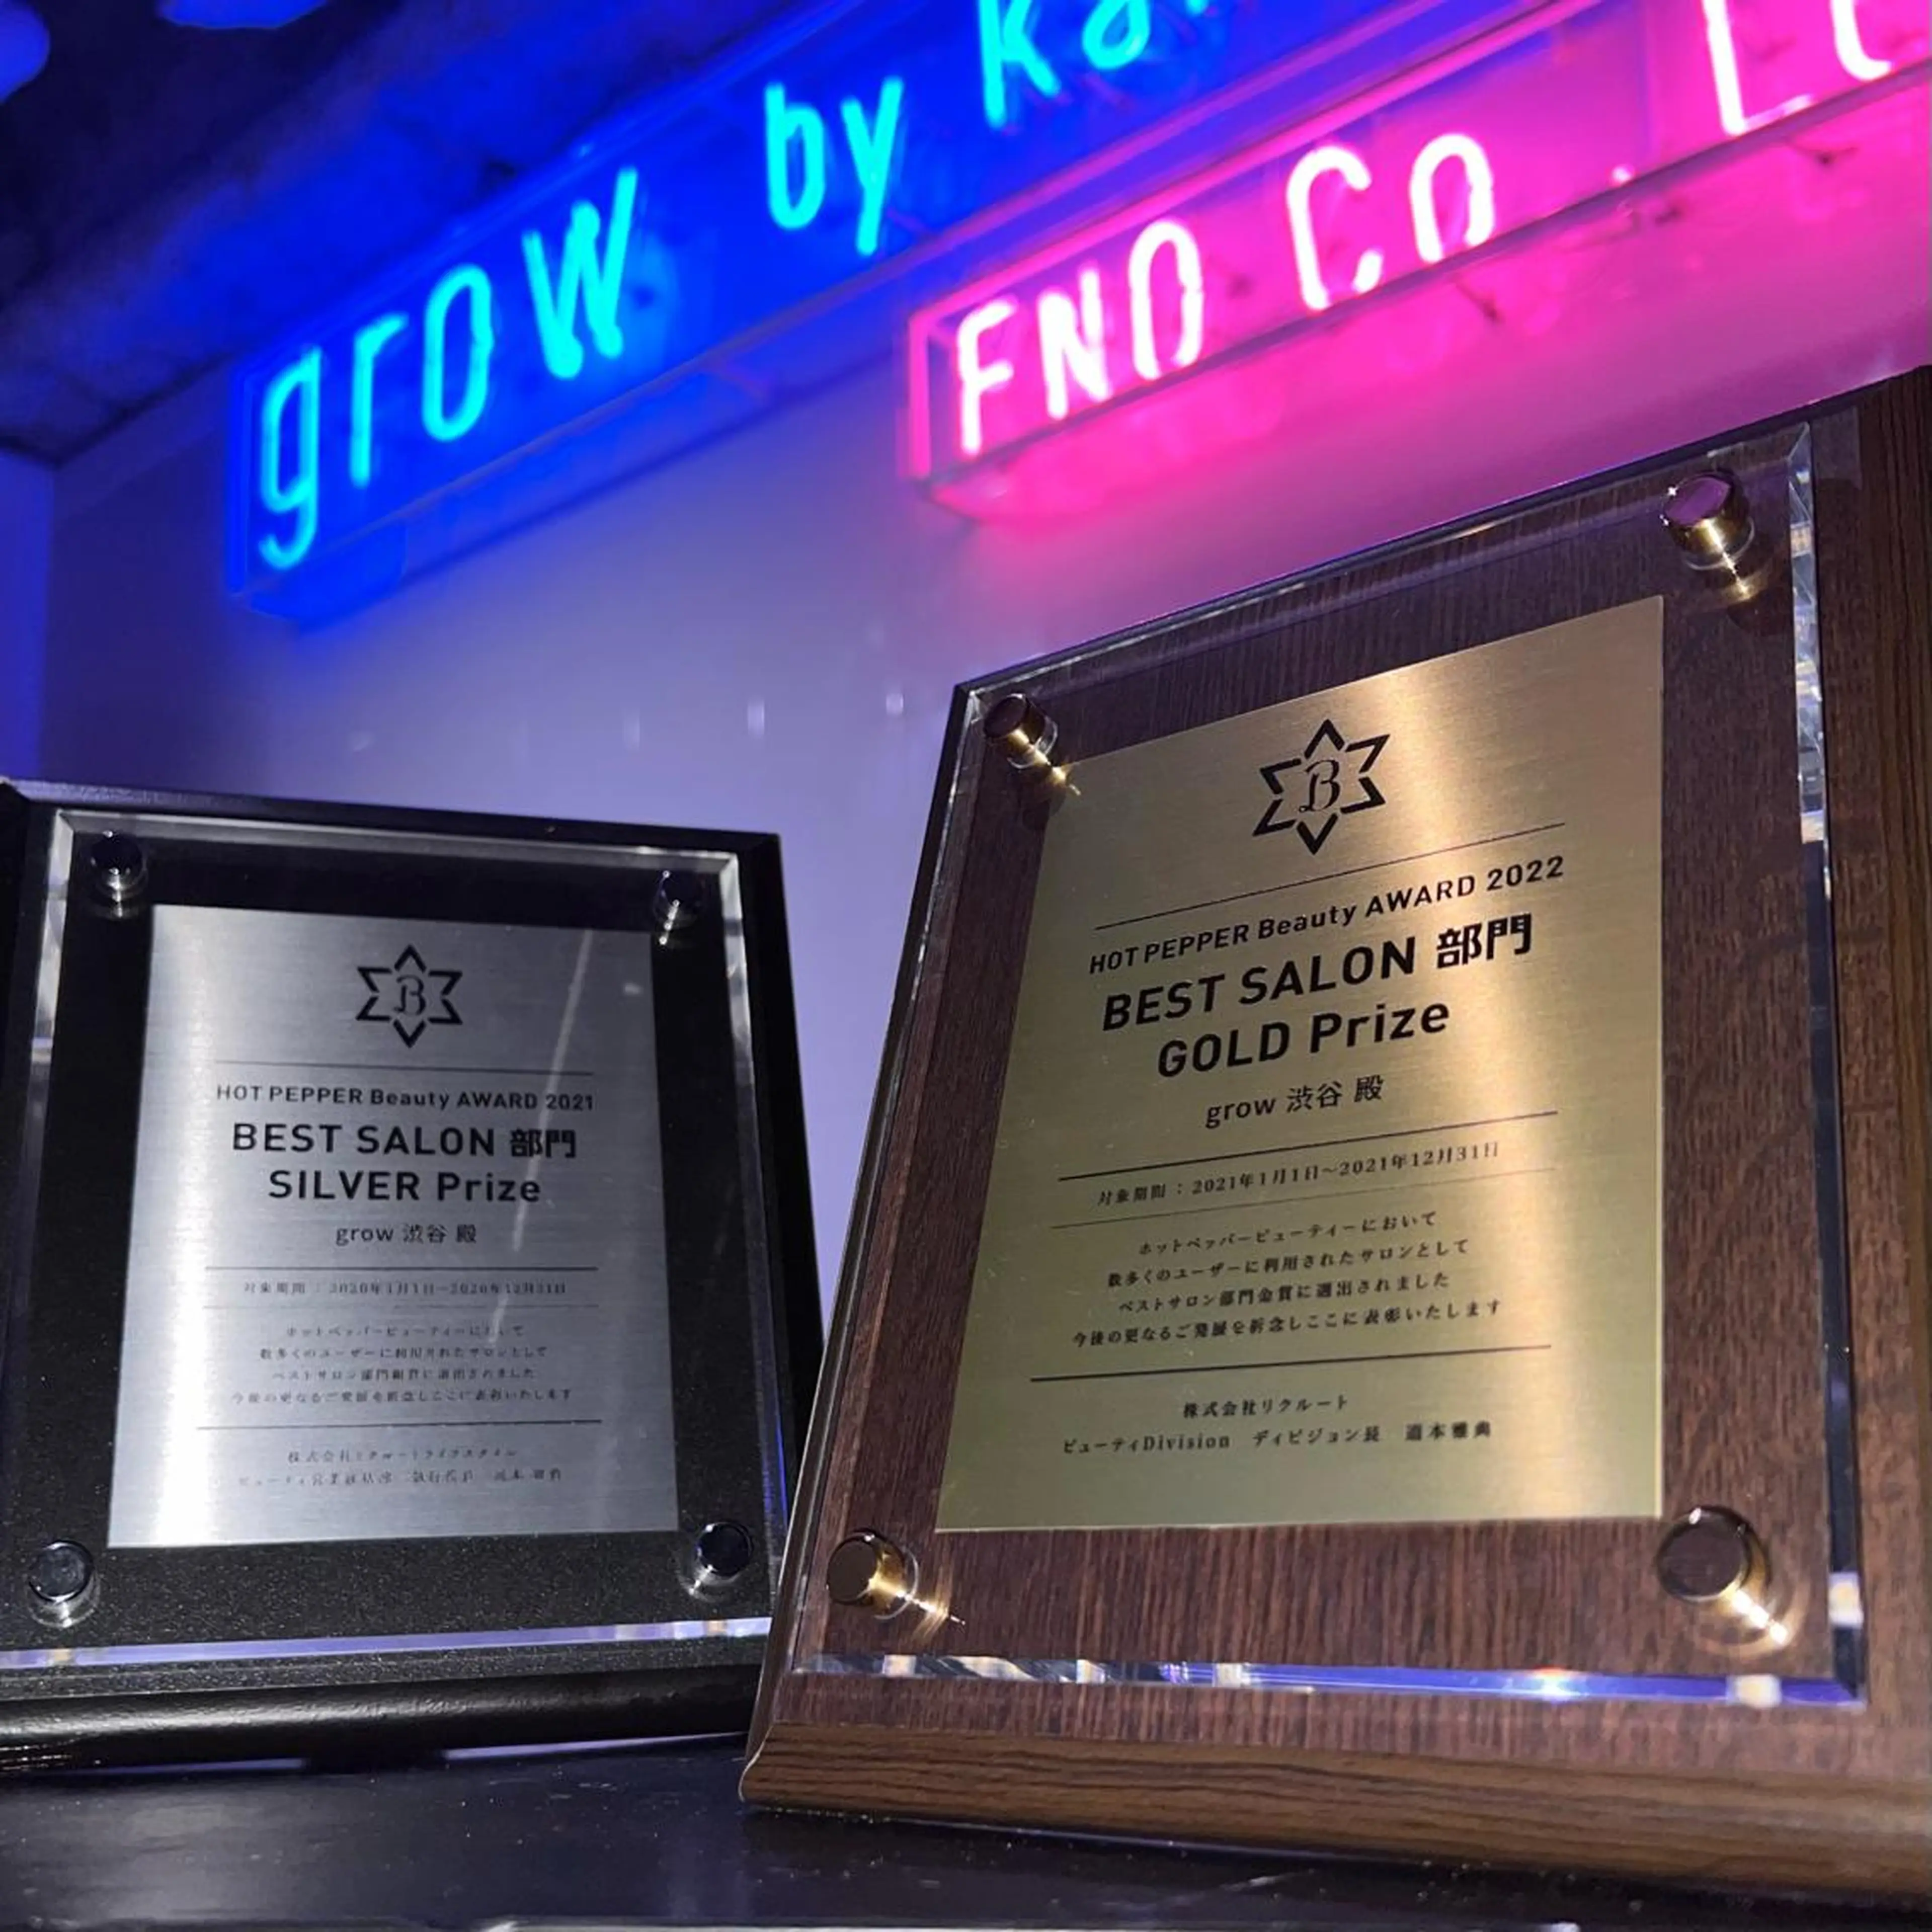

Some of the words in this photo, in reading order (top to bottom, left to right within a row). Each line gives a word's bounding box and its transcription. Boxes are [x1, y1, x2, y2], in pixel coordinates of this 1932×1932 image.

[259, 165, 639, 571] grow
[766, 74, 904, 256] by
[956, 219, 1204, 455] FNO
[1090, 946, 1139, 975] HOT
[1144, 924, 1249, 964] PEPPER
[1258, 903, 1357, 940] Beauty
[1365, 874, 1476, 918] AWARD
[1487, 855, 1564, 891] 2022
[1102, 974, 1226, 1031] BEST
[1237, 936, 1415, 1005] SALON
[1436, 913, 1533, 970] 部門
[1158, 1022, 1290, 1077] GOLD
[1310, 1003, 1450, 1054] Prize
[216, 1085, 263, 1101] HOT
[269, 1086, 363, 1104] PEPPER
[370, 1089, 449, 1110] Beauty
[457, 1091, 537, 1109] AWARD
[546, 1093, 593, 1110] 2021
[1204, 1096, 1276, 1129] grow
[1286, 1082, 1343, 1113] 渋谷
[1354, 1074, 1384, 1102] 殿
[233, 1123, 342, 1152] BEST
[357, 1125, 495, 1156] SALON
[511, 1129, 577, 1158] 部門
[268, 1170, 420, 1200] SILVER
[438, 1171, 540, 1202] Prize
[336, 1227, 394, 1247] grow
